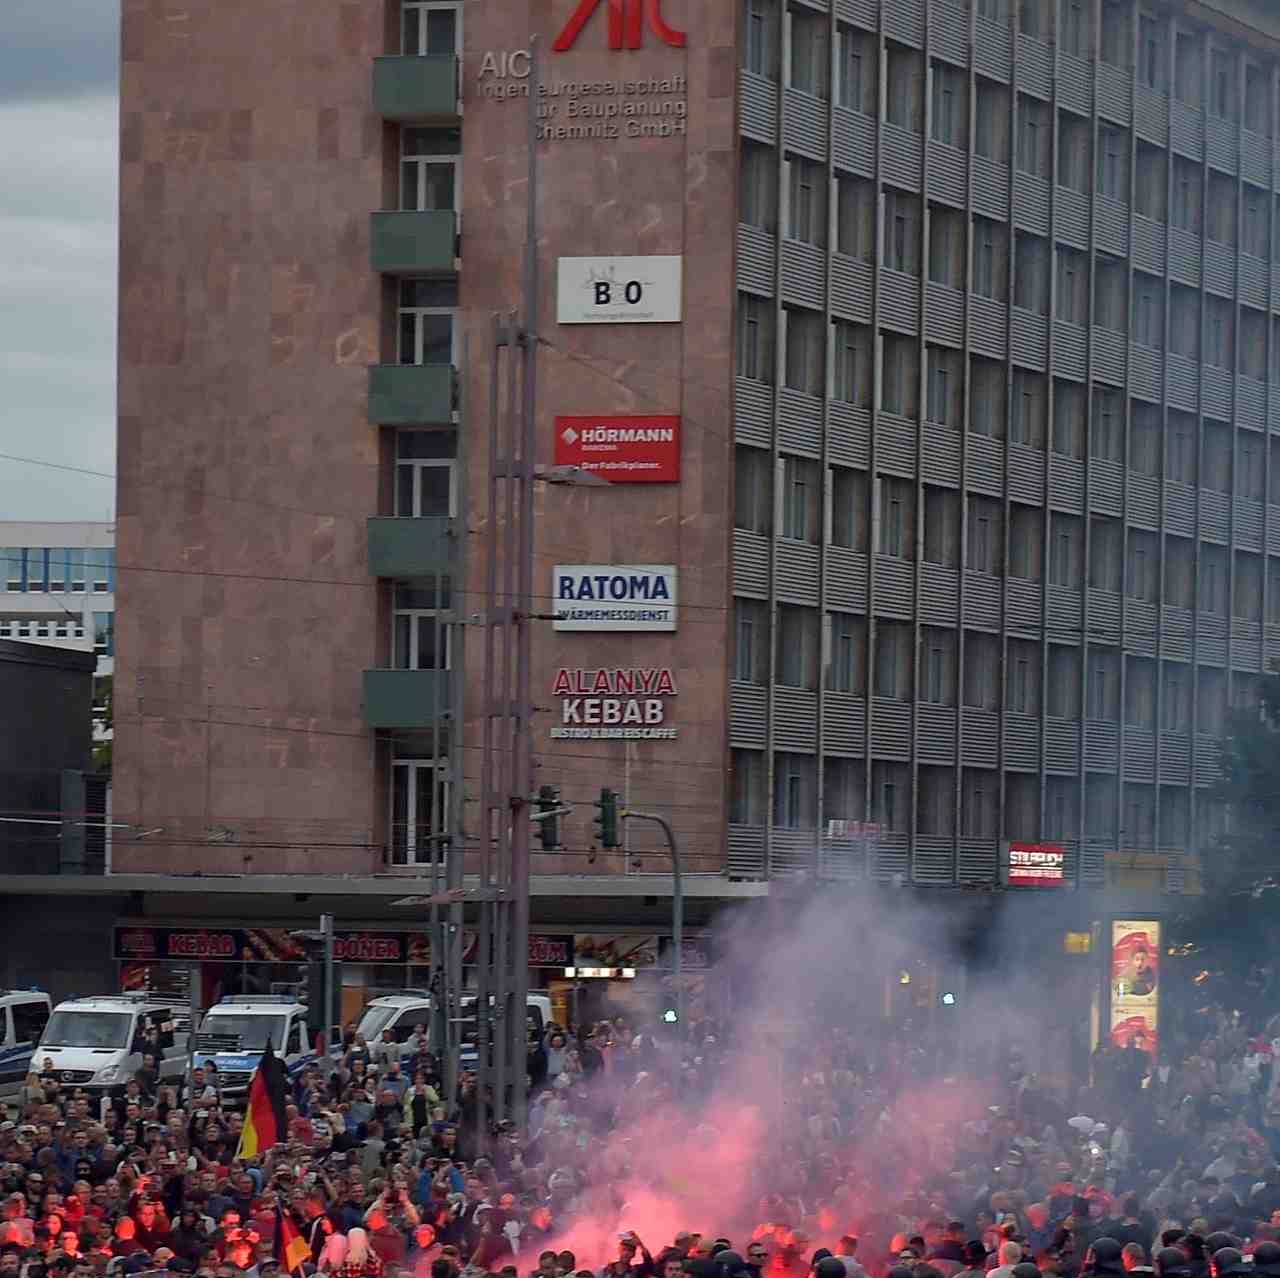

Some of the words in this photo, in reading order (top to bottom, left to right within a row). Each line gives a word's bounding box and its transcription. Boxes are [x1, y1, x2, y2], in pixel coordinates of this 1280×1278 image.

[477, 50, 532, 79] AIC
[625, 118, 687, 138] GmbH
[581, 425, 673, 442] HÖRMANN
[559, 575, 669, 600] RATOMA
[552, 667, 679, 696] ALANYA
[561, 698, 664, 725] KEBAB
